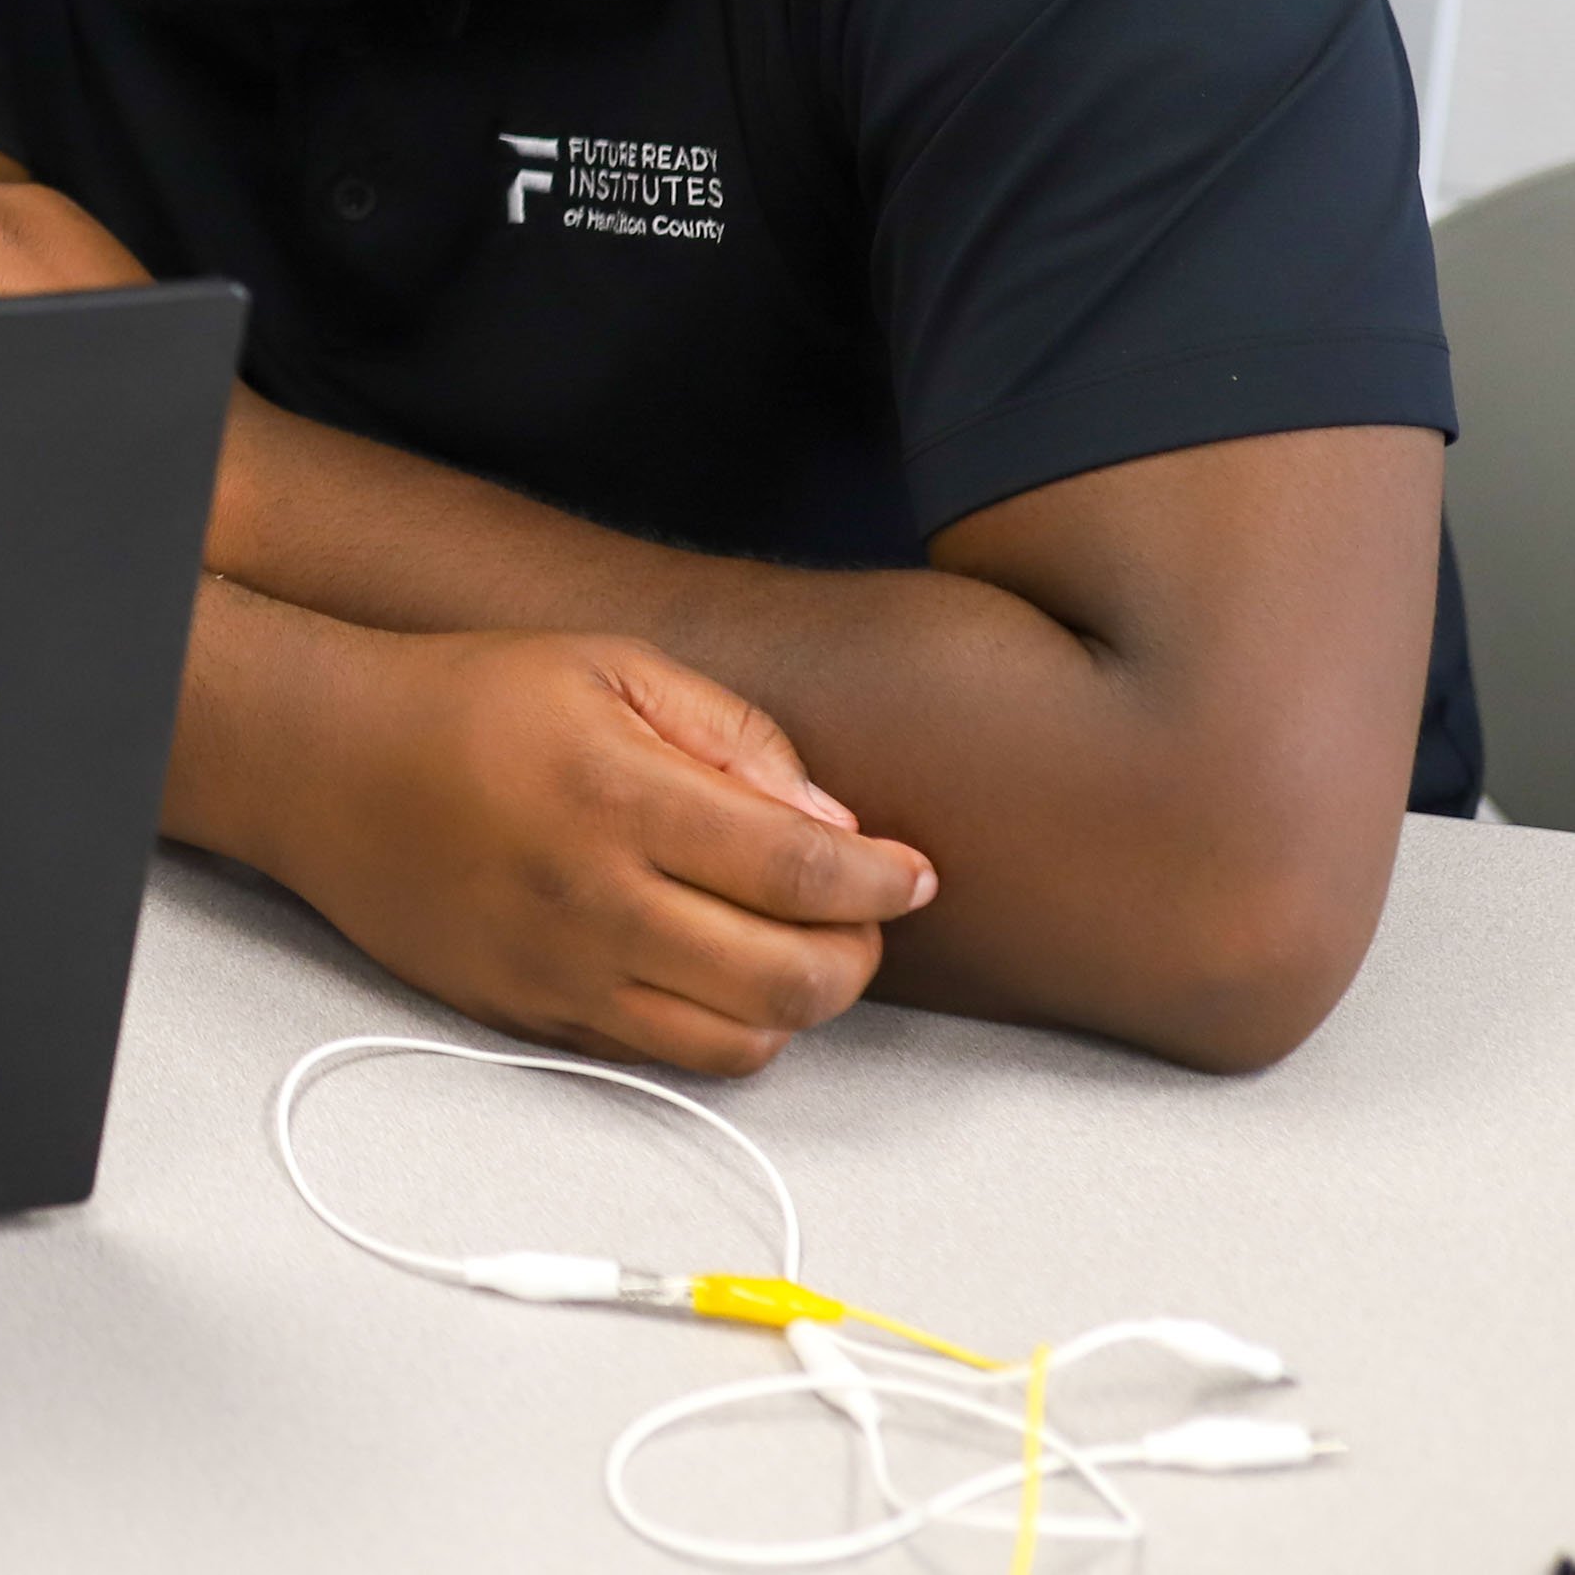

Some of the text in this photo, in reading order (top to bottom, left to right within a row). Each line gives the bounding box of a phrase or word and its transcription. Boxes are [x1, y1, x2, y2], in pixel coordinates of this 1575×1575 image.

[568, 136, 718, 173] FUTURE READY
[568, 166, 725, 209] INSTITUTES
[563, 205, 585, 229] of
[651, 214, 726, 244] County
